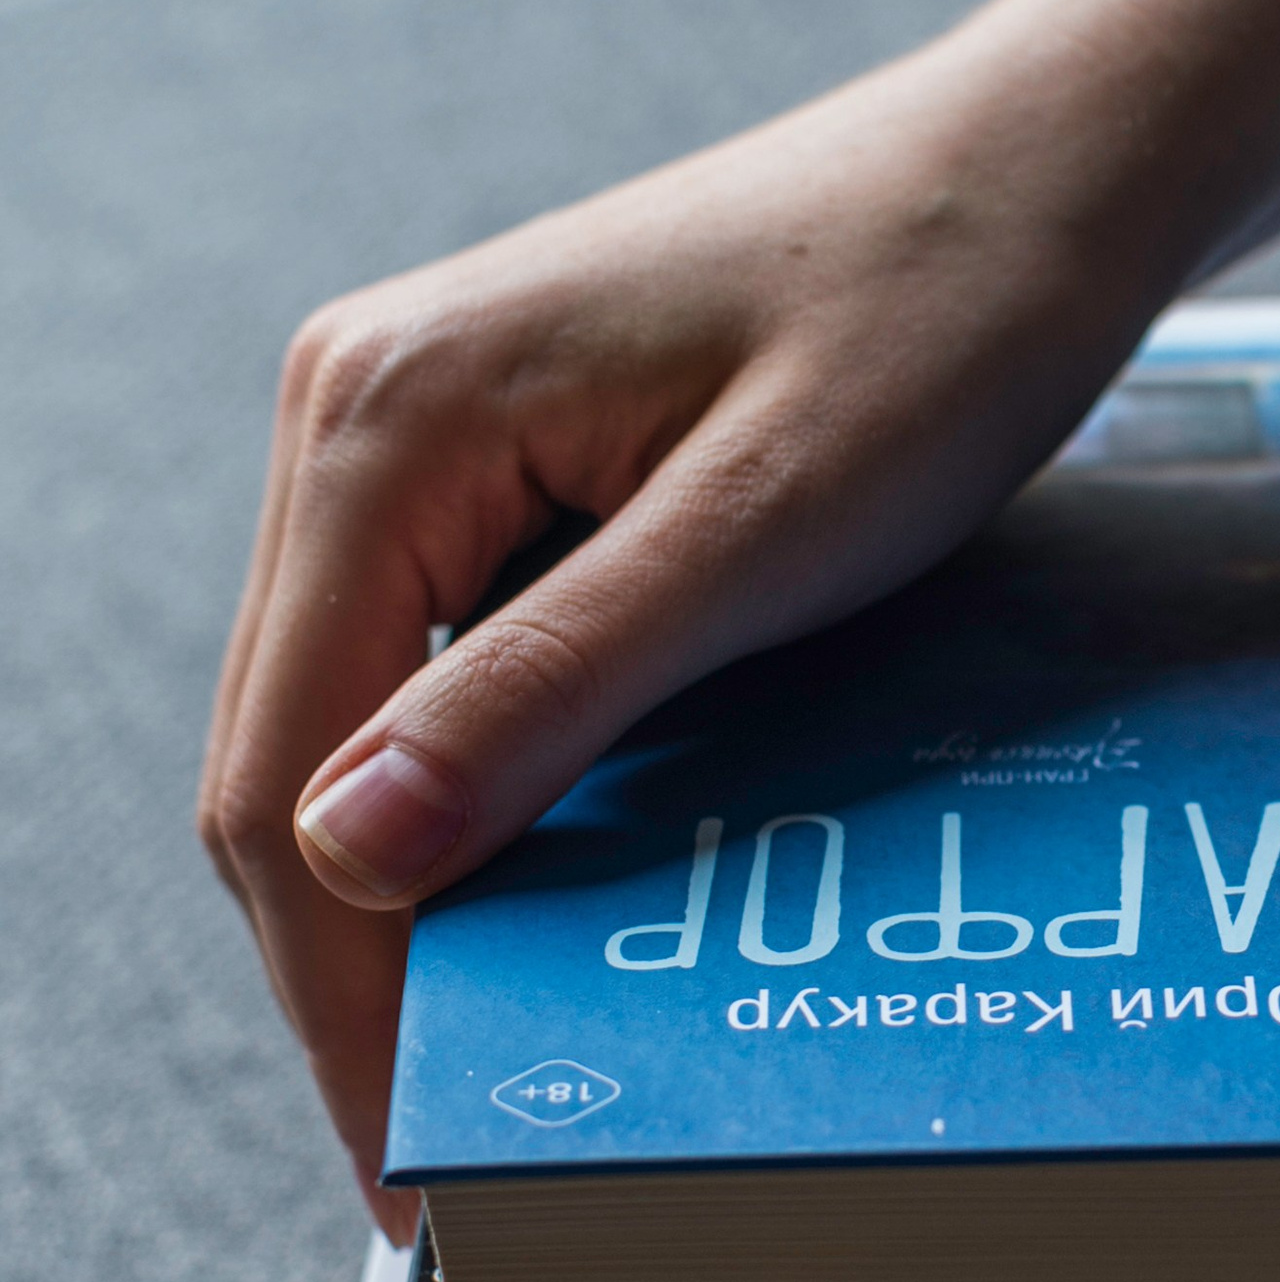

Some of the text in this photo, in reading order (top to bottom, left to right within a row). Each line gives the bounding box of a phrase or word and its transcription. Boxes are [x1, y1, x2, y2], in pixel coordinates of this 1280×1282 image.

[960, 768, 1090, 787] ГРАН-ПРИ
[725, 982, 1075, 1034] Каракур
[517, 1081, 594, 1104] 18+
